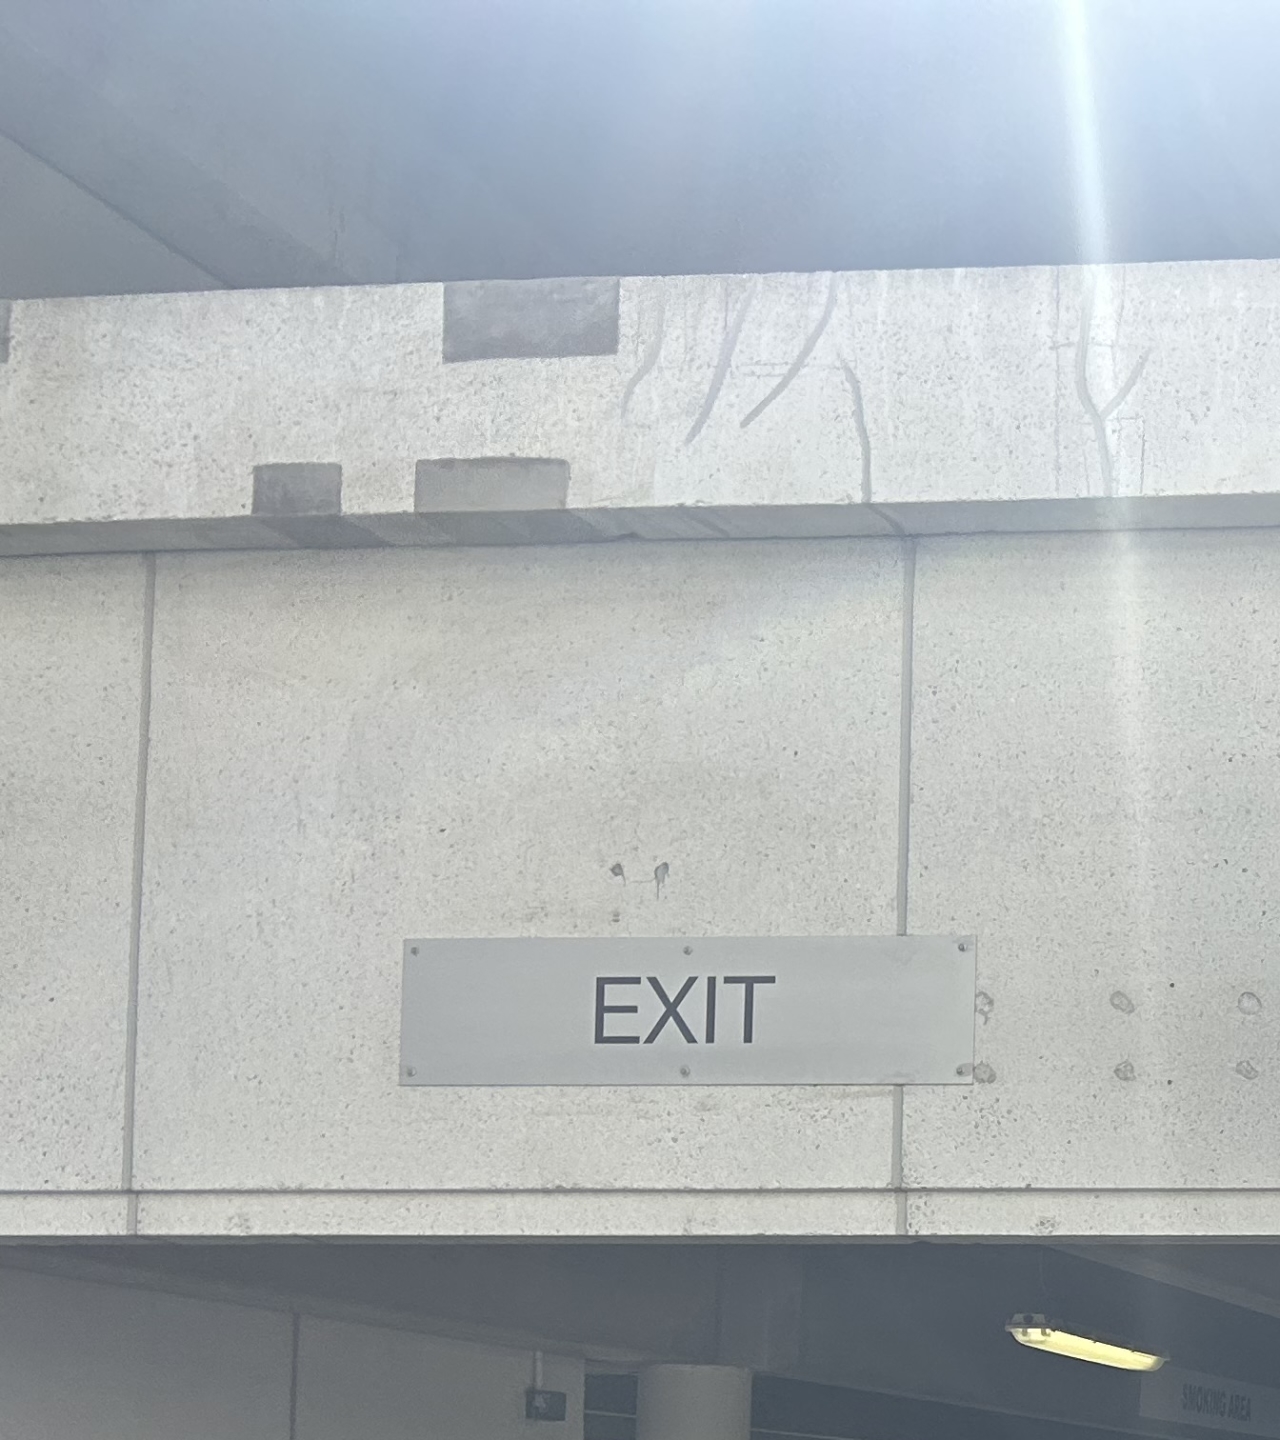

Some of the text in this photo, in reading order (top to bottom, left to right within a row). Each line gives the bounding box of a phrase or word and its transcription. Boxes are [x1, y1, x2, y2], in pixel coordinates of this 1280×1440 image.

[593, 975, 777, 1045] EXIT
[1182, 1384, 1252, 1422] SMOKING AREA
